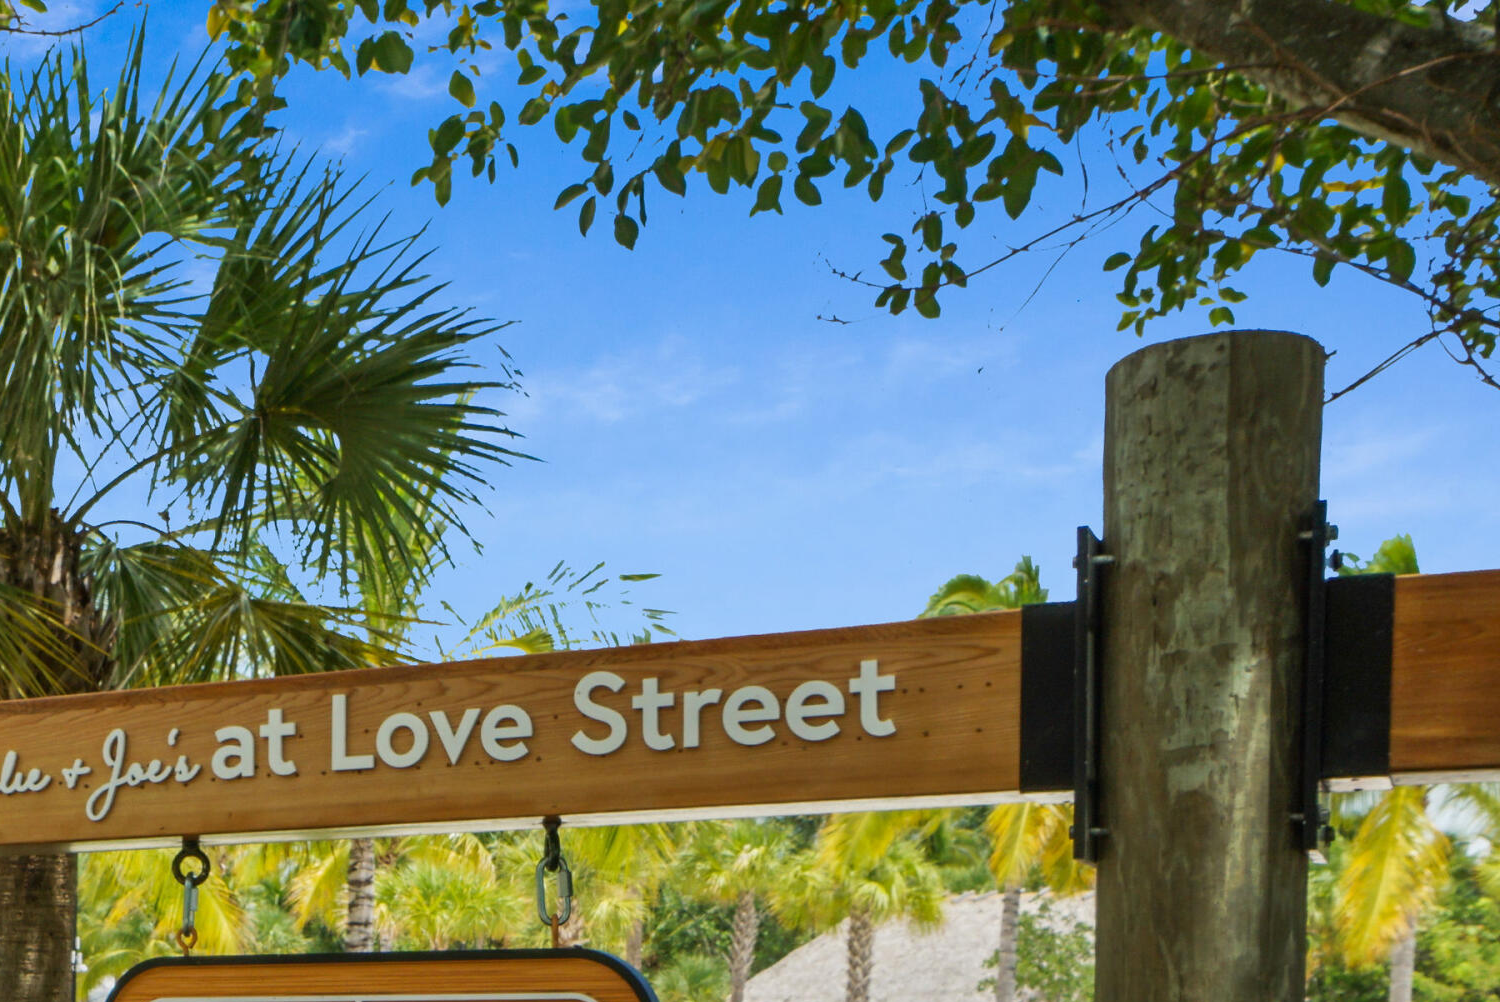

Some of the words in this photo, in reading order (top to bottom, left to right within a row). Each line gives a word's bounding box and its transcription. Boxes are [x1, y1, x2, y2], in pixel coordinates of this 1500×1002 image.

[86, 728, 201, 821] Joe's
[211, 708, 297, 780] at
[331, 694, 534, 772] Love
[570, 659, 897, 755] Street
